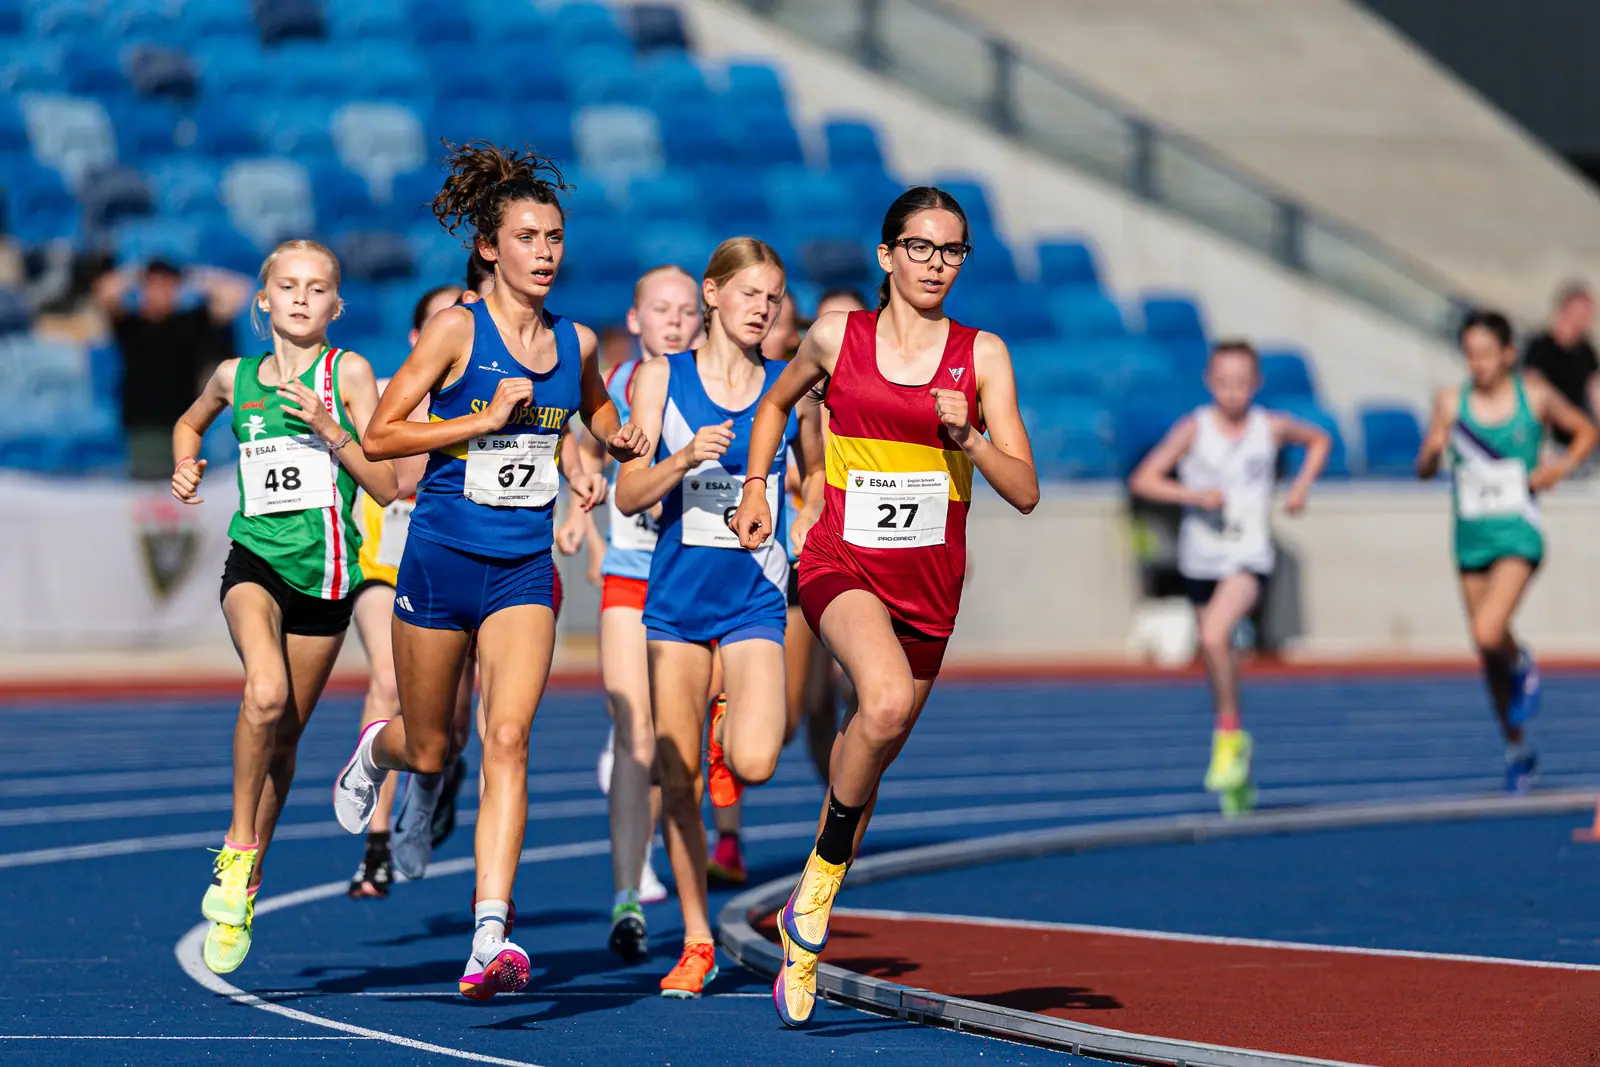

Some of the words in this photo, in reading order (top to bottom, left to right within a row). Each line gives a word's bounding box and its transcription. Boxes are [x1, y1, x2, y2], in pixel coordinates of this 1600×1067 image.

[470, 398, 570, 430] SOPSHIR
[255, 445, 277, 456] ESAA
[493, 440, 519, 449] ESAA
[265, 466, 302, 492] 48
[497, 463, 536, 488] 67
[870, 479, 896, 487] ESAA
[705, 482, 732, 490] ESAA
[877, 503, 919, 528] 27
